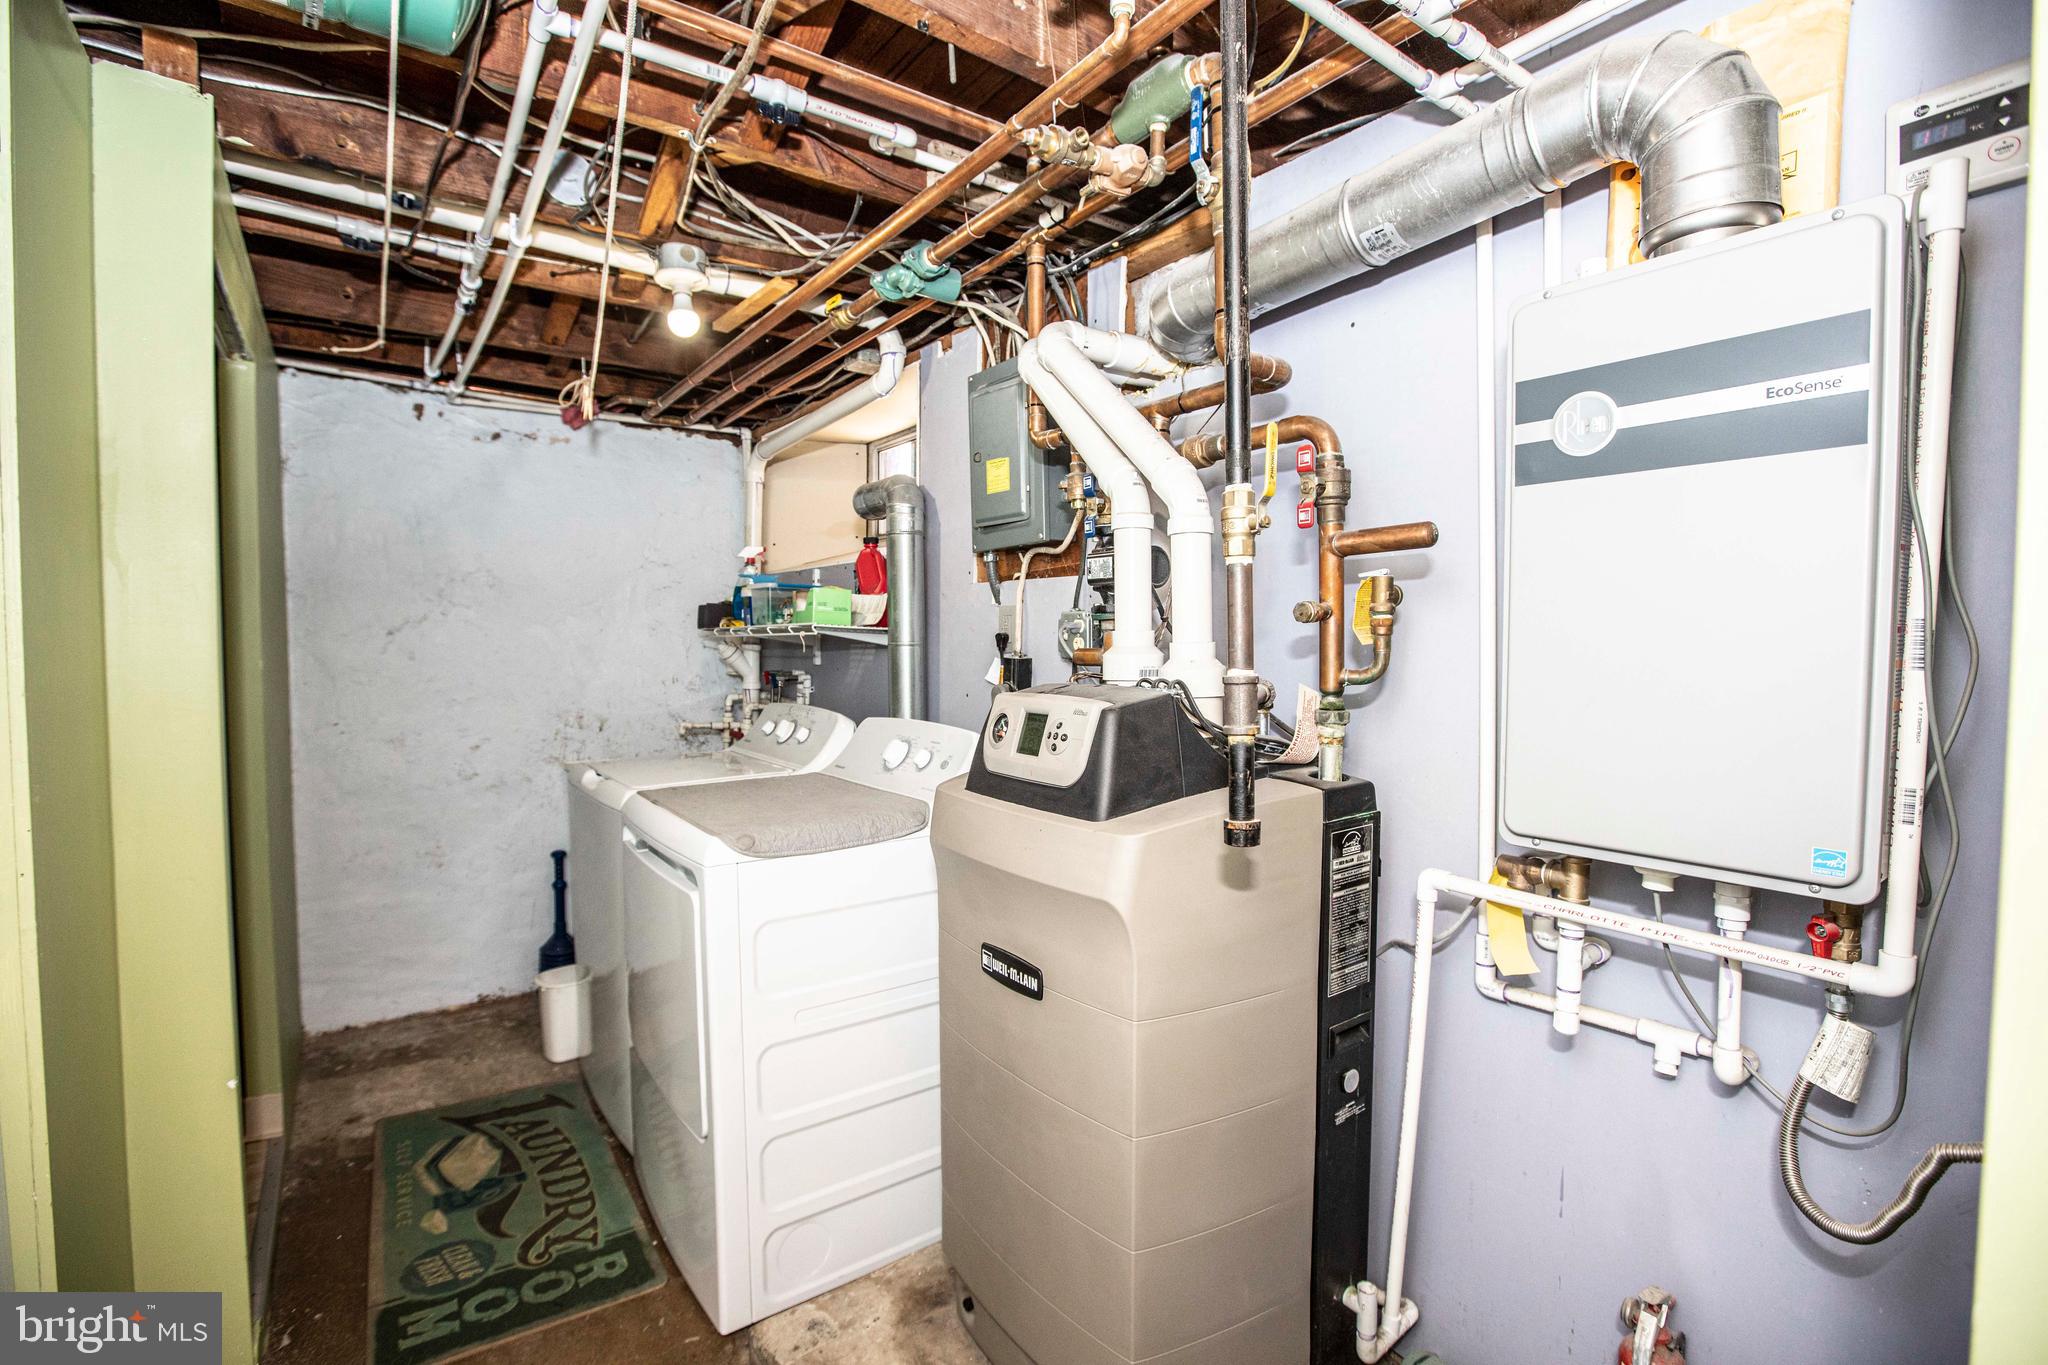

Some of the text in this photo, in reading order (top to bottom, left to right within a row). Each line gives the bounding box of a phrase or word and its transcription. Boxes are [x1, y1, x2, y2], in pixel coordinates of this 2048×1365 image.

[1765, 377, 1842, 399] EcoSense
[1285, 720, 1302, 757] WARNING
[1543, 903, 1630, 928] CHARLOTTE
[1641, 926, 1685, 941] PIPE
[440, 1094, 599, 1269] LAUNDRY
[398, 1250, 628, 1350] ROOM
